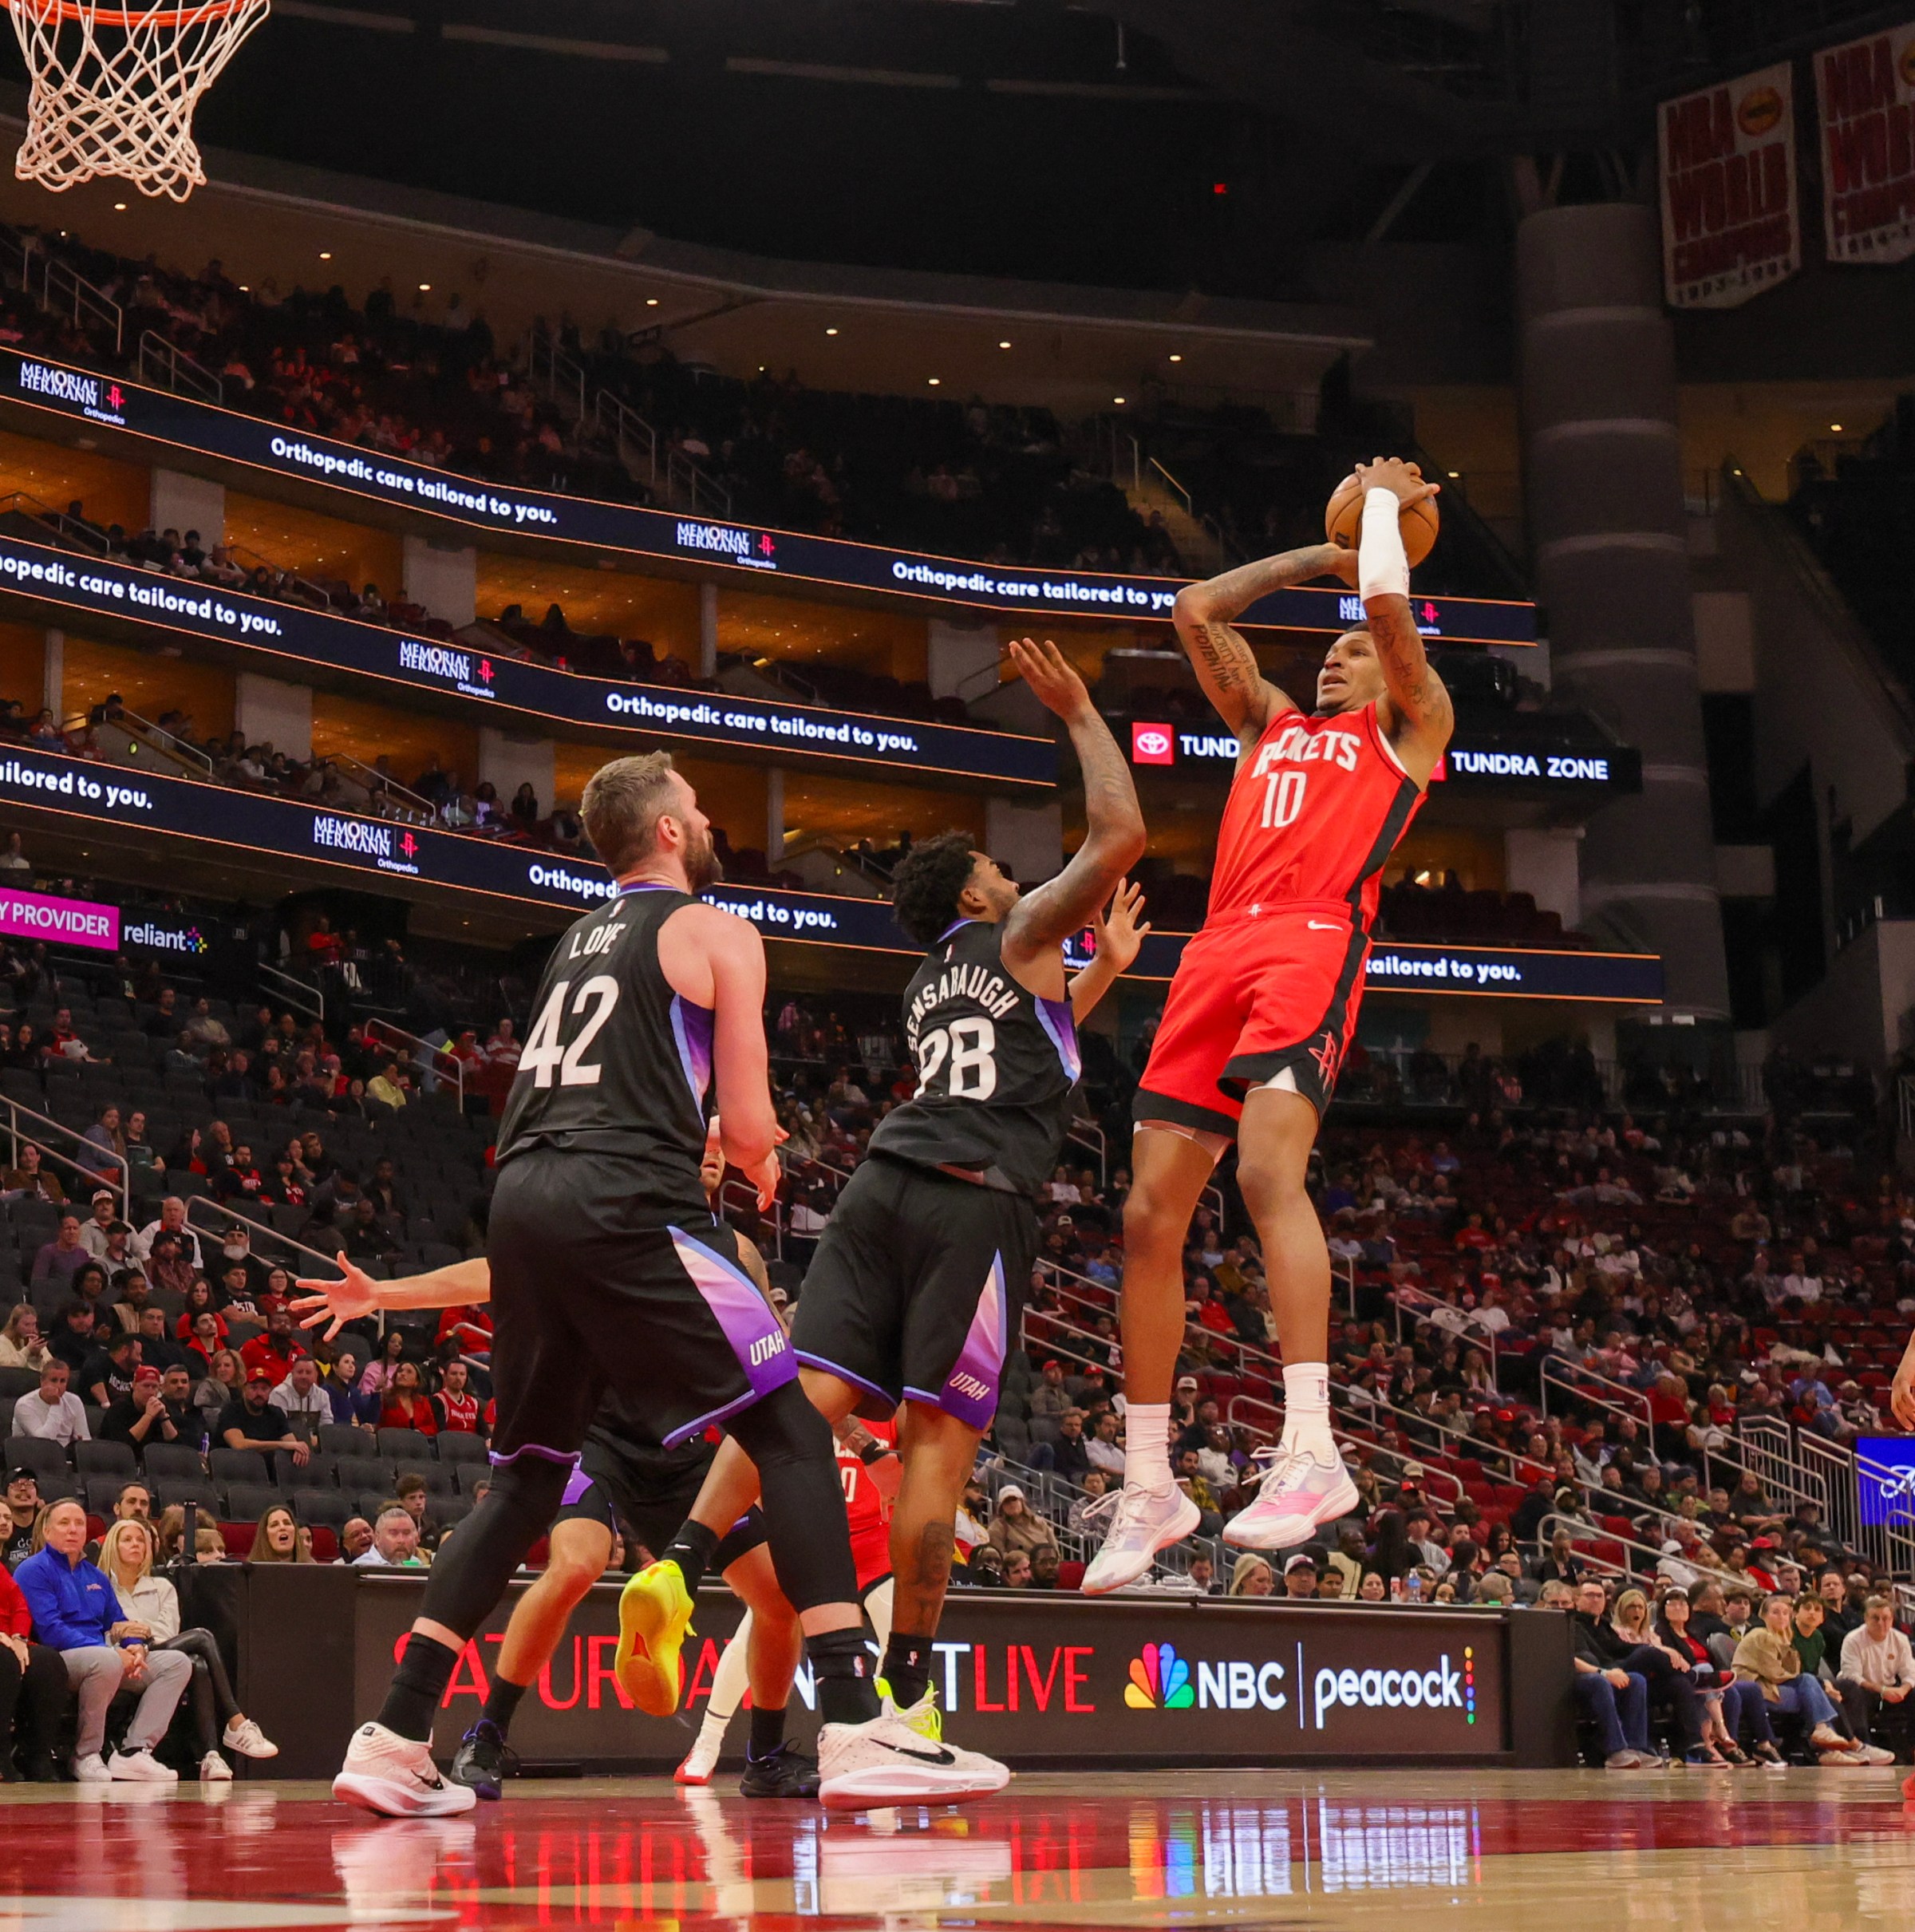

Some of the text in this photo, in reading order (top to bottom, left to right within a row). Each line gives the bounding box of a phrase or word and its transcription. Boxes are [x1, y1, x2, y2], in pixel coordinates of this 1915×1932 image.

[20, 373, 97, 406] HERMANN
[21, 362, 97, 394] MEMORIAL
[84, 406, 125, 425] Orthopedics
[270, 437, 558, 524] Orthopedic care tailored to you.
[677, 523, 750, 545] MEMORIAL
[677, 532, 750, 555] HERMANN
[736, 556, 776, 569] Orthopedics
[892, 561, 994, 593] Orthopedic
[996, 582, 1040, 598] care
[1042, 582, 1123, 603] tailored
[1125, 587, 1148, 605] to
[79, 575, 124, 599] care
[128, 582, 211, 619] tailored
[214, 603, 237, 625] to
[240, 612, 282, 636] you.
[400, 641, 469, 669] MEMORIAL
[400, 651, 469, 681] HERMANN
[457, 682, 495, 698] Orthopedics
[606, 693, 918, 752] Orthopedic care tailored to you.
[1451, 751, 1609, 780] TUNDRA ZONE
[77, 776, 101, 799] to
[105, 785, 153, 810] you.
[1260, 770, 1307, 828] 10
[314, 816, 391, 844] MEMORIAL
[314, 828, 391, 857] HERMANN
[377, 858, 419, 875] Orthopedics
[12, 902, 110, 938] PROVIDER
[766, 903, 790, 923] to
[792, 910, 837, 930] you.
[124, 923, 188, 952] reliant
[568, 923, 626, 960] LOVE
[1450, 959, 1474, 978] to
[1476, 964, 1522, 984] you.
[906, 962, 1020, 1052] SENSABAUGH
[517, 974, 620, 1088] 42
[913, 1016, 997, 1101] 28
[748, 1329, 786, 1367] UTAH
[949, 1371, 990, 1401] UTAH
[973, 1643, 1096, 1713] LIVE
[1198, 1661, 1287, 1711] NBC
[1314, 1653, 1463, 1730] peacock
